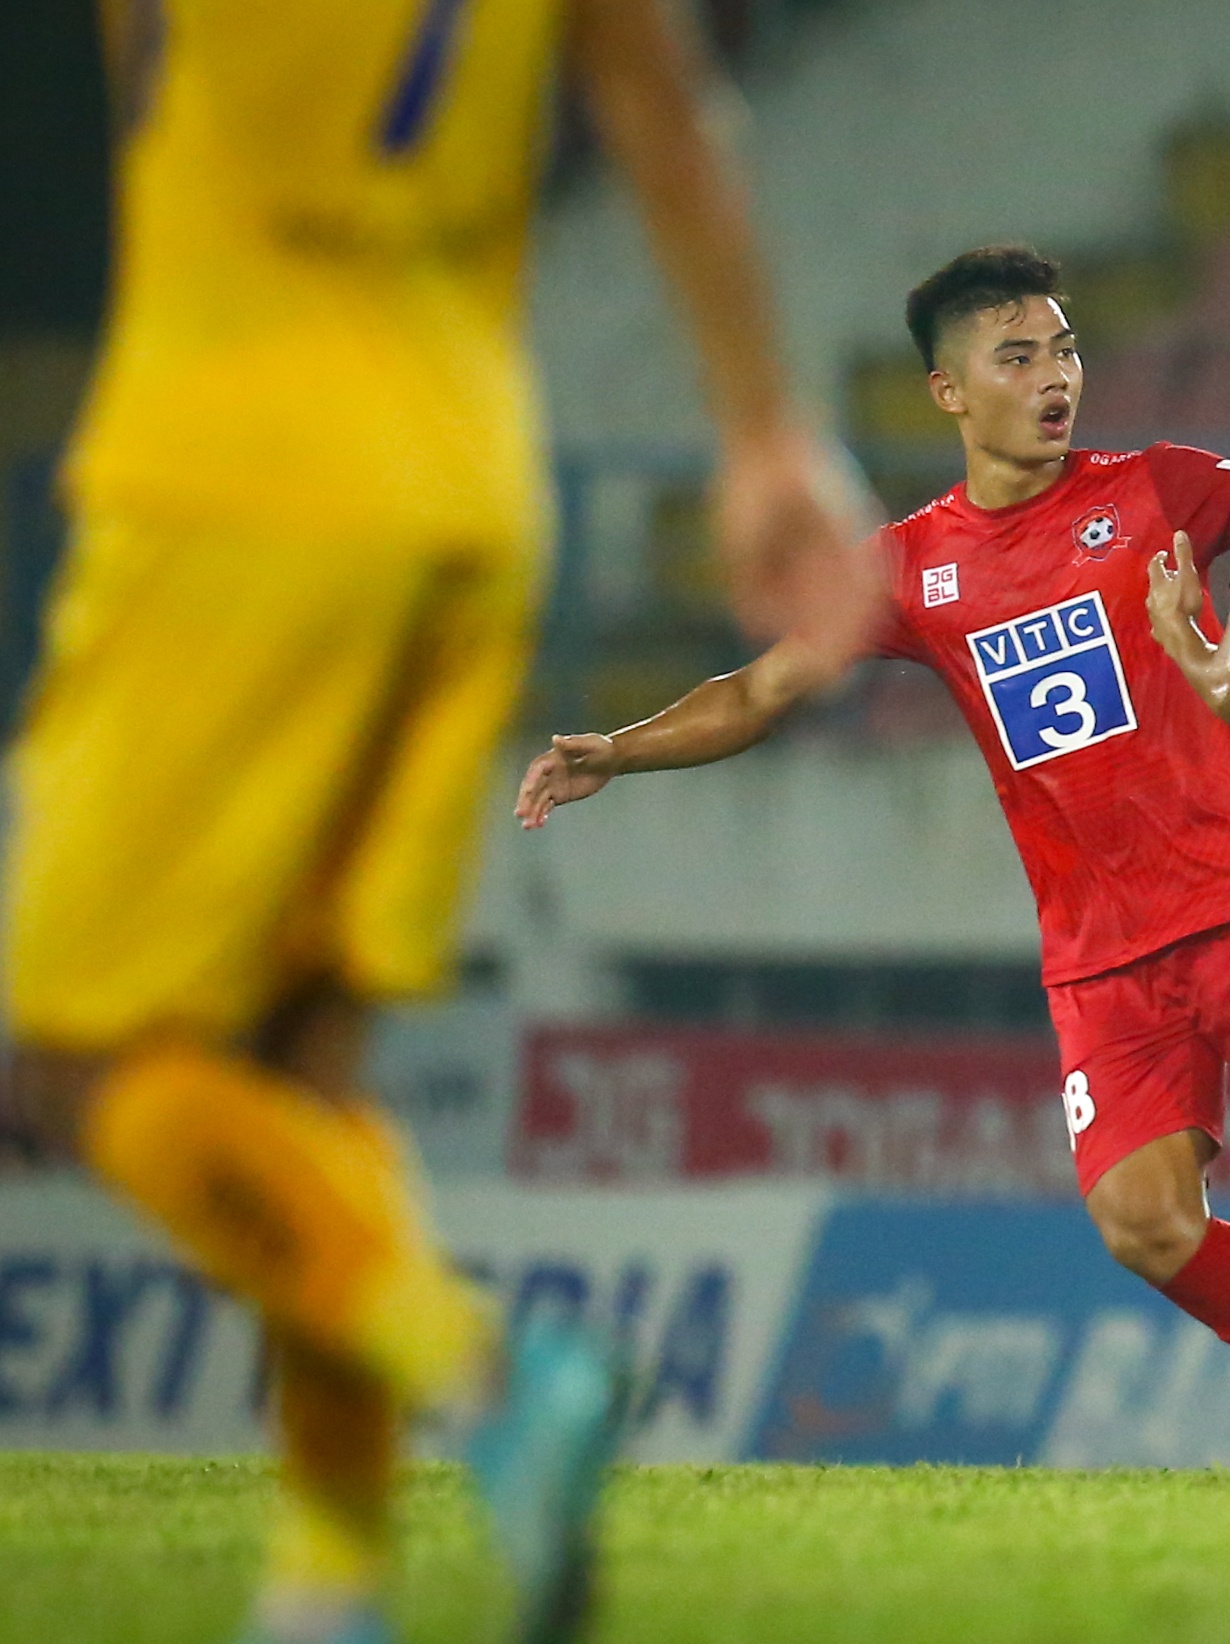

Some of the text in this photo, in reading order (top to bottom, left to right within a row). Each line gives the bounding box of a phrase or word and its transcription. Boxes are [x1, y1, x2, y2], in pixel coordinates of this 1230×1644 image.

[927, 567, 954, 587] JG
[927, 585, 956, 603] BL
[980, 608, 1094, 665] VTC
[1030, 671, 1097, 749] 3
[1061, 1069, 1096, 1151] 8
